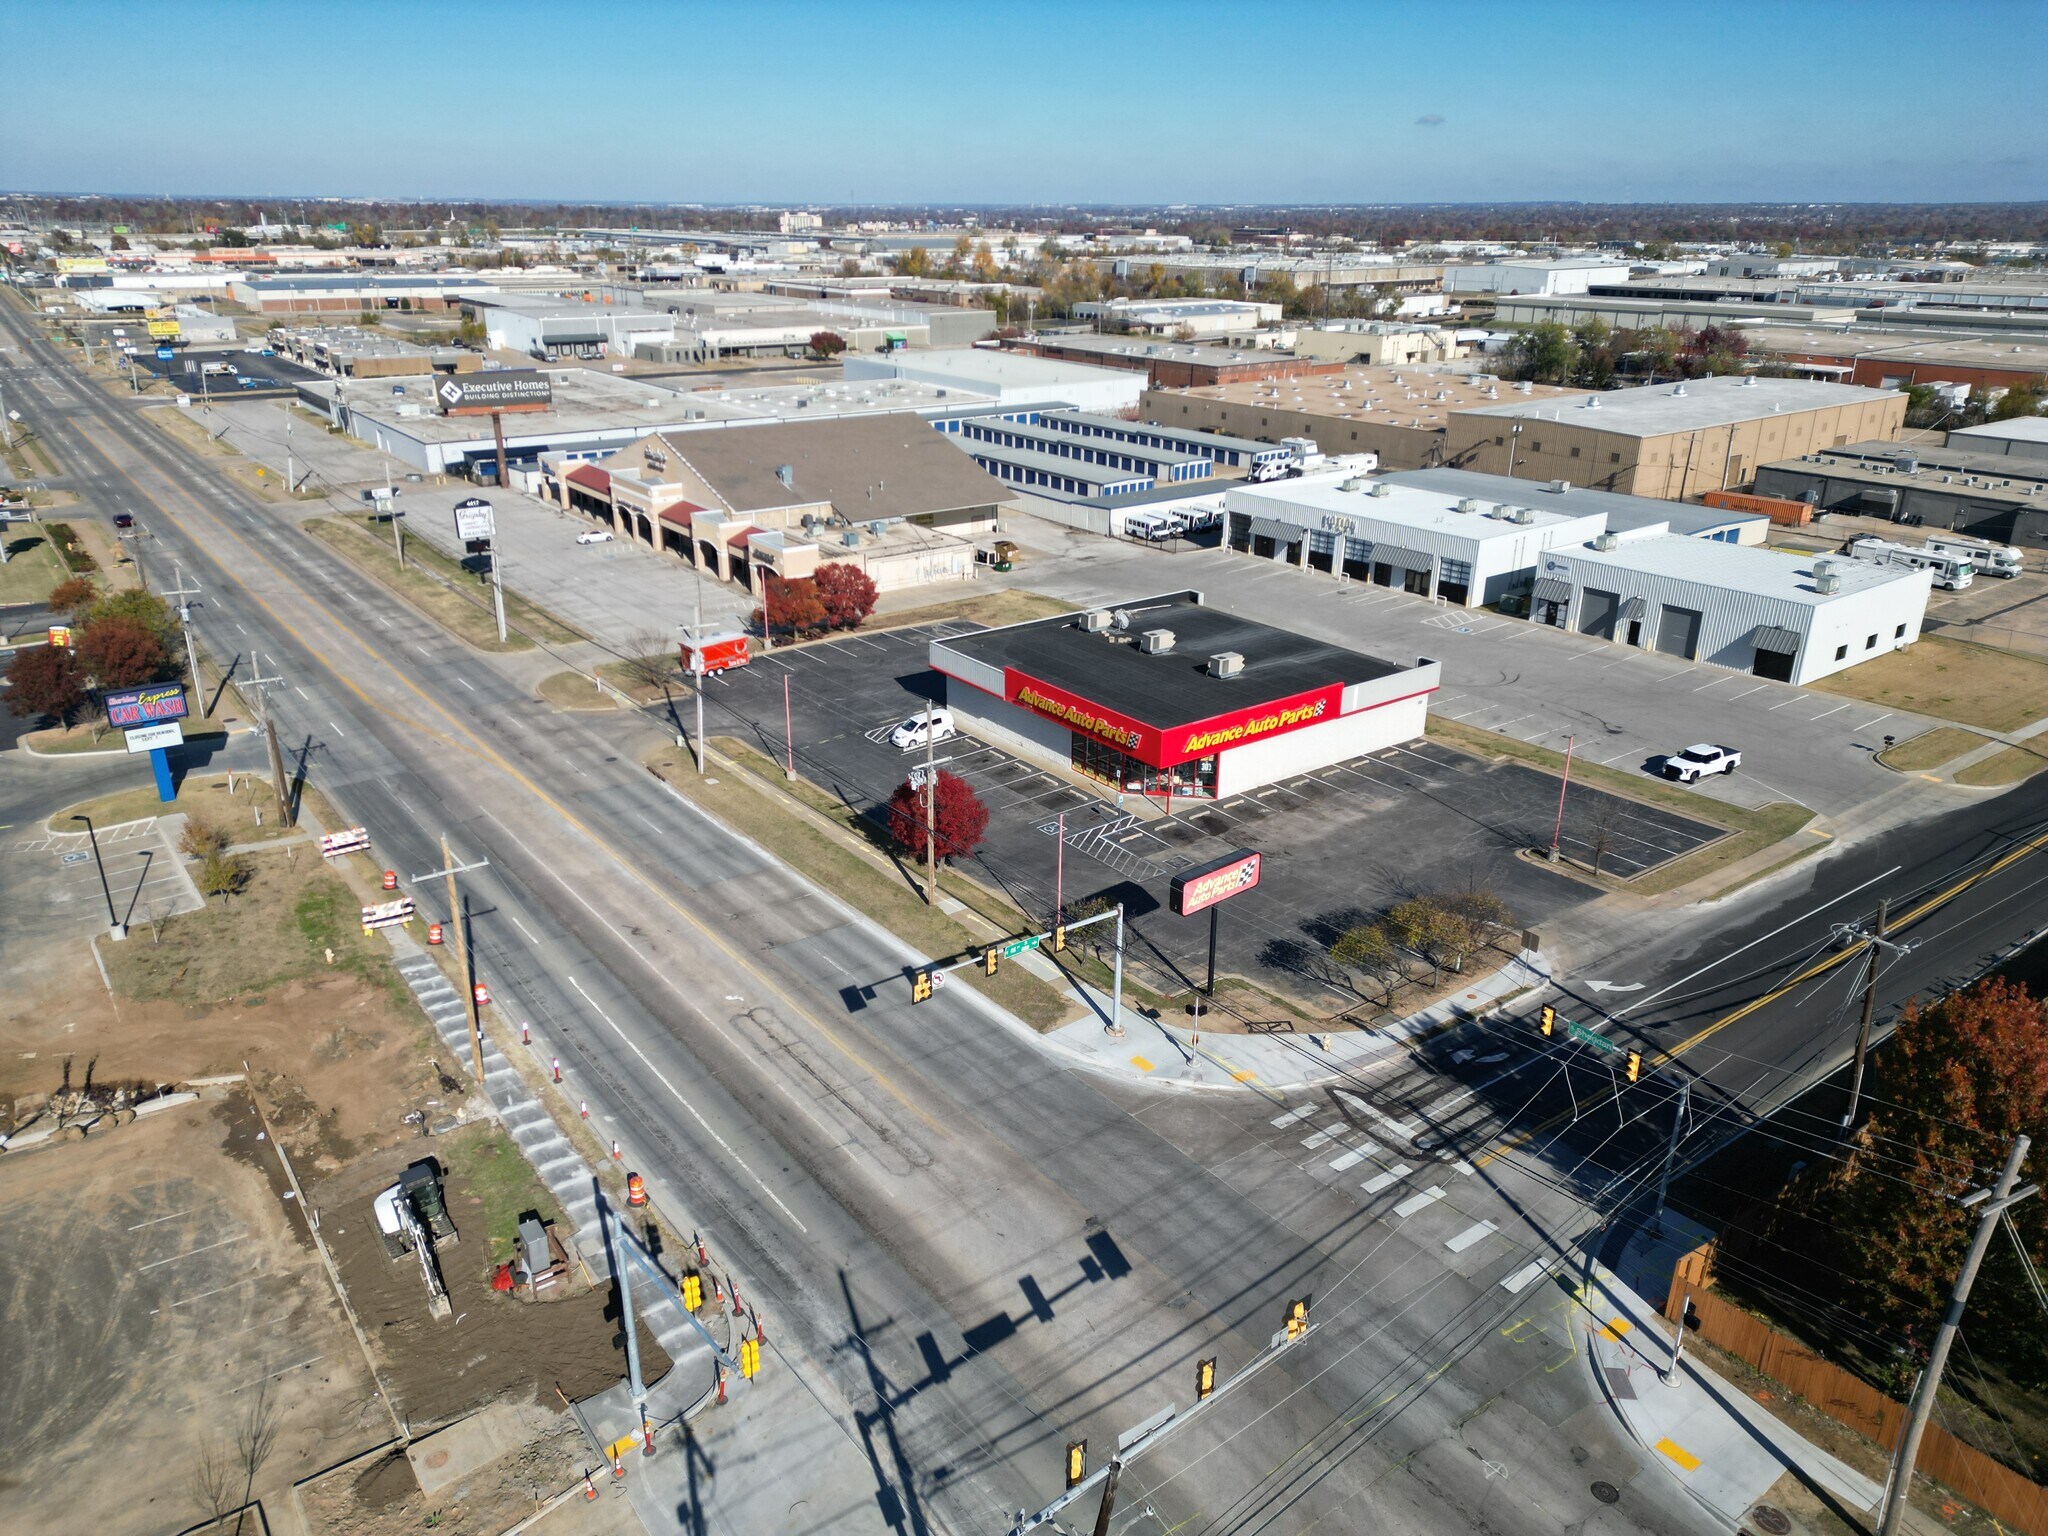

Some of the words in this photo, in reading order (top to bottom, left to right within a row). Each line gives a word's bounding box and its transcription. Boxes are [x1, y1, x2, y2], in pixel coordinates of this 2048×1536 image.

[462, 381, 512, 393] Executive
[514, 380, 550, 391] Homes
[53, 635, 65, 646] 5
[138, 688, 180, 705] Express
[110, 705, 141, 723] CAR
[142, 698, 185, 718] WASH
[1018, 687, 1065, 716] Advance
[1063, 706, 1095, 730] Auto
[1093, 718, 1129, 744] Parts
[1184, 725, 1244, 753] Advance
[1244, 714, 1279, 737] Auto
[1278, 704, 1315, 727] Parts
[1186, 892, 1211, 909] Auto
[1210, 881, 1237, 899] Parts
[1192, 869, 1239, 896] Advance
